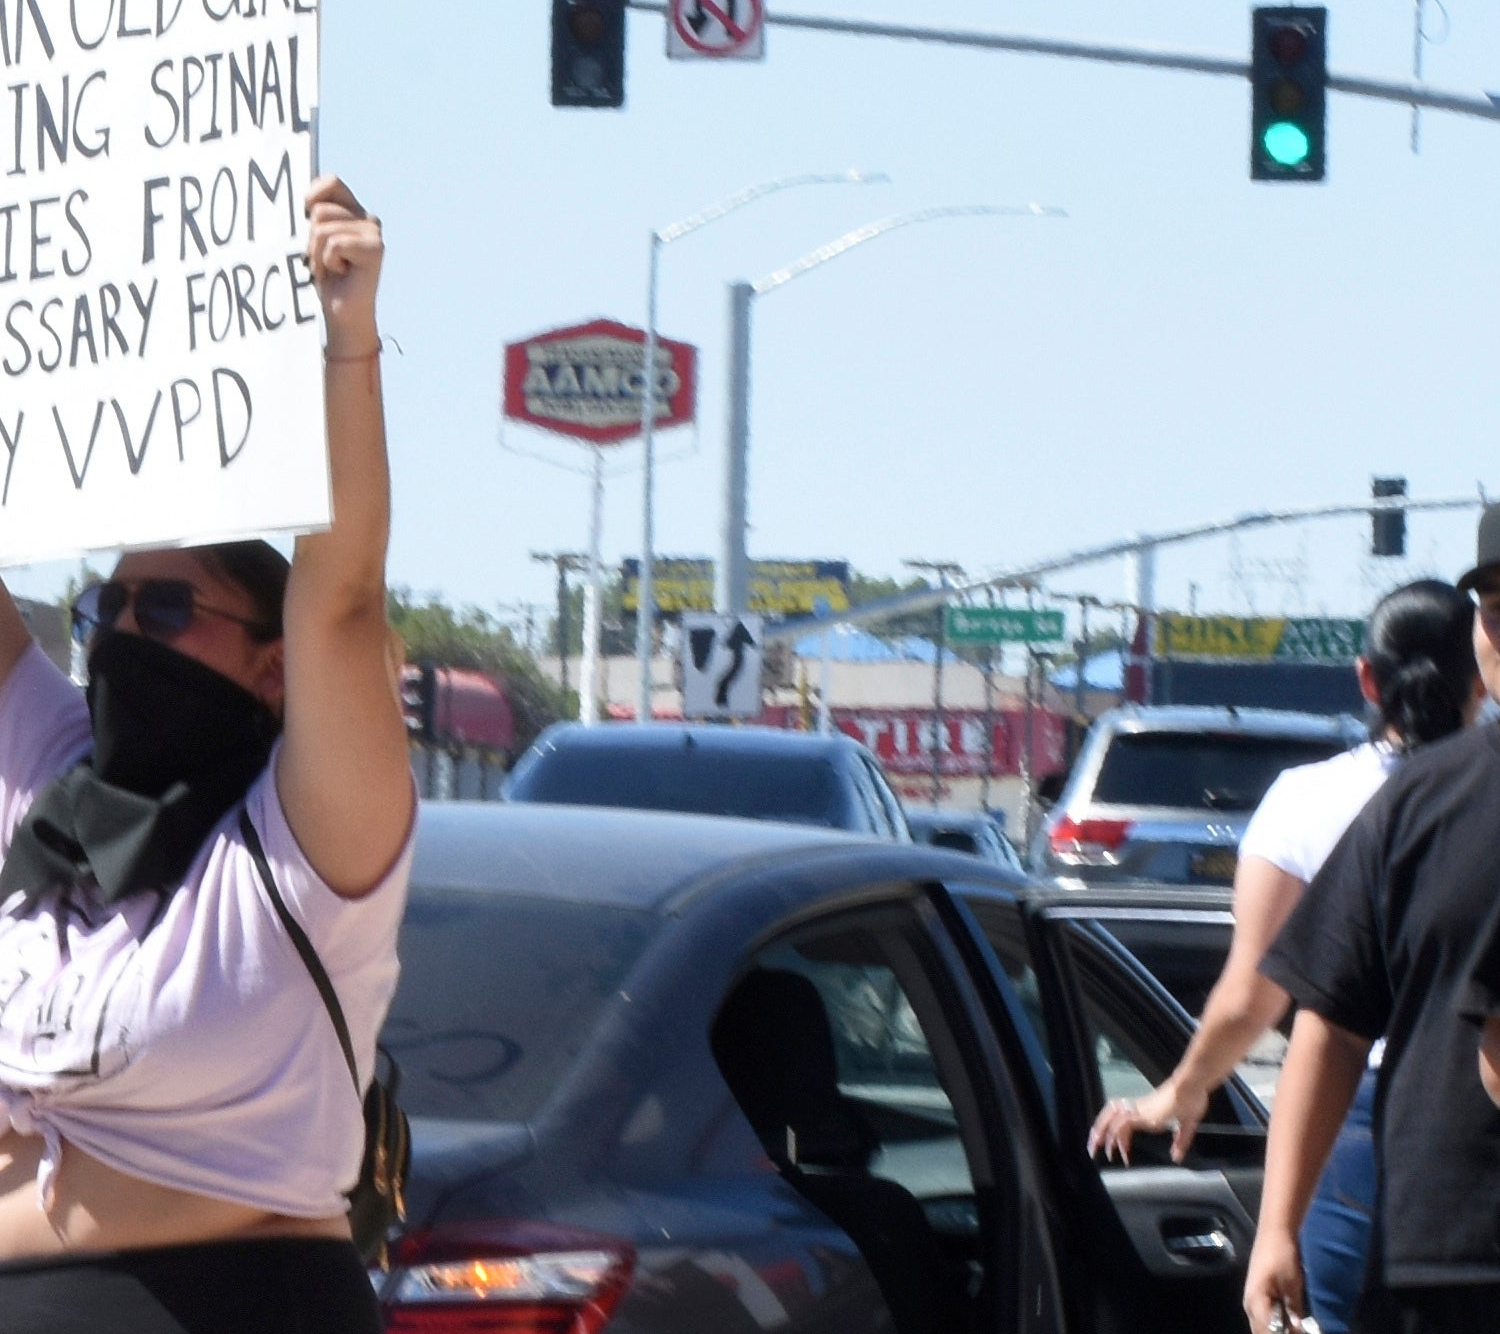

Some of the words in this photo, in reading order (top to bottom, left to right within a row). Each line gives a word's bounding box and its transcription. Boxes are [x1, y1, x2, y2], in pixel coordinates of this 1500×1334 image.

[144, 35, 311, 148] SPINAL
[141, 151, 297, 265] FROM
[187, 251, 317, 352] FORCE
[52, 367, 253, 490] VVPD
